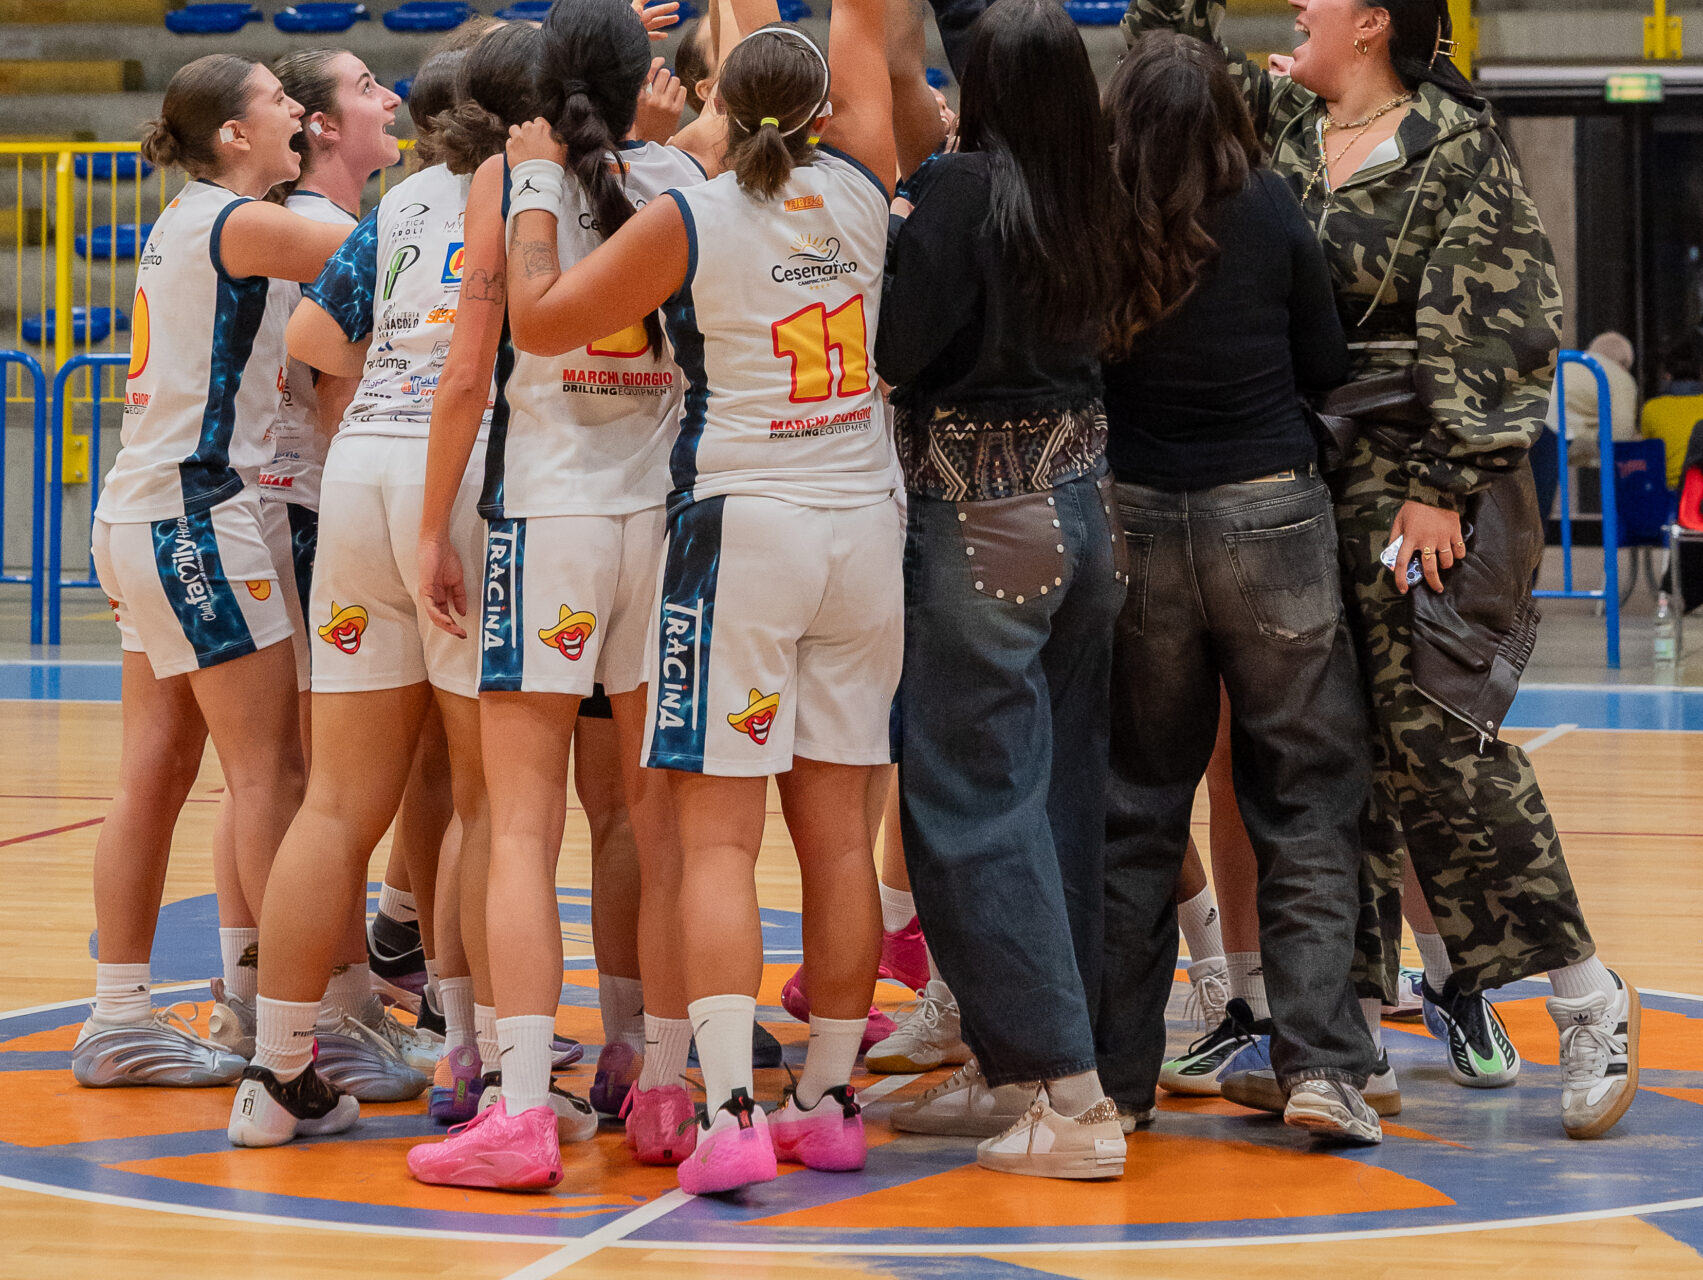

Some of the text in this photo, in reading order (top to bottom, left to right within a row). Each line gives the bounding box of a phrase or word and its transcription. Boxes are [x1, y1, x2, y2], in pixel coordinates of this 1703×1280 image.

[771, 260, 858, 283] Cesenatico
[771, 293, 871, 404] 11
[562, 369, 673, 386] MARCHI GIORGIO
[770, 415, 828, 431] MARCHI
[171, 516, 216, 621] Club family Hote
